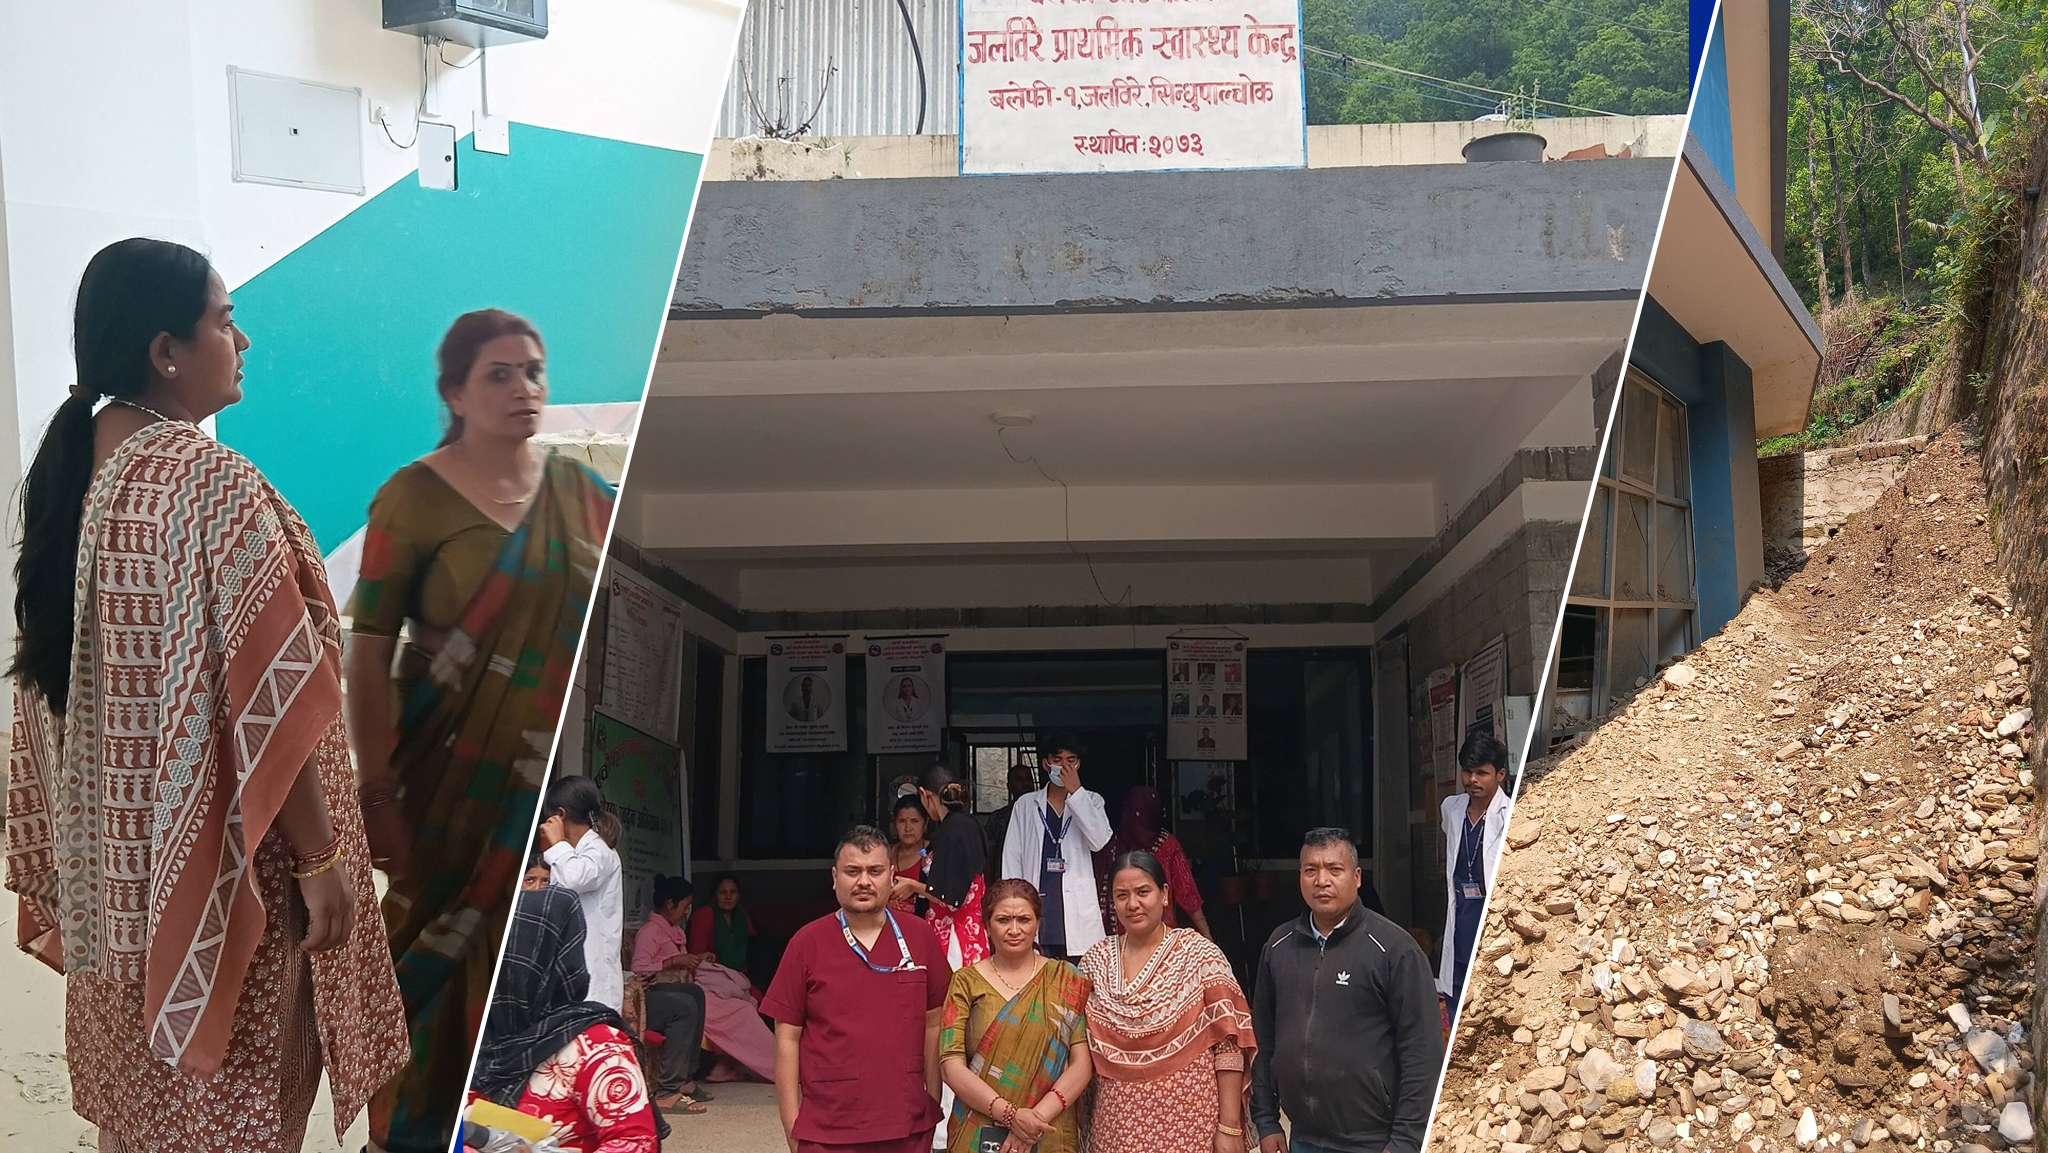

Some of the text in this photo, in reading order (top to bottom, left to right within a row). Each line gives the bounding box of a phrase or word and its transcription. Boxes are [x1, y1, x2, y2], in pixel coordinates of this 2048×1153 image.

[1051, 15, 1143, 63] प्राथमिक
[1151, 25, 1241, 61] स्वास्थ्य
[1245, 13, 1297, 64] केन्द्र
